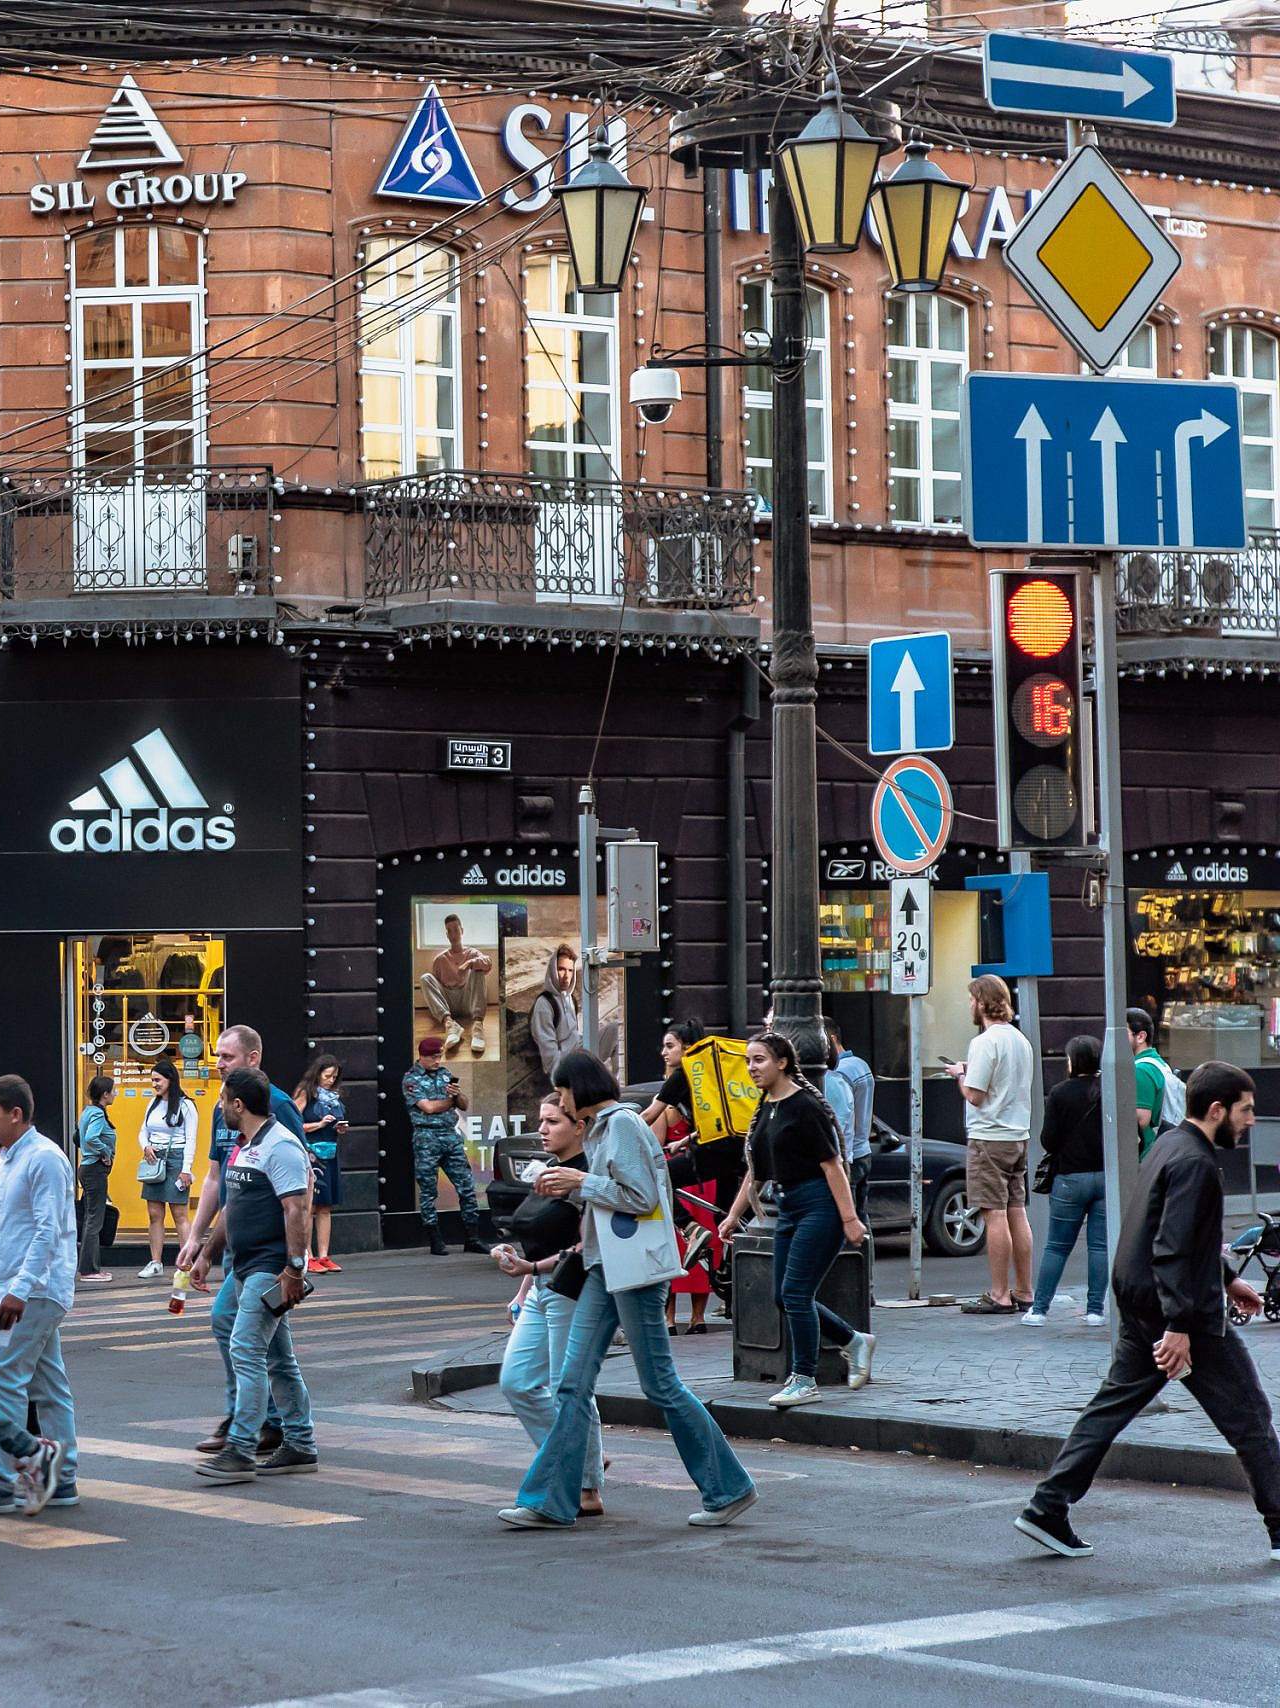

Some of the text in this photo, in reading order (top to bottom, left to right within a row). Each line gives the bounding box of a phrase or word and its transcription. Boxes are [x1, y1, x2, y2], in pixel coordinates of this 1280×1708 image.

[30, 172, 248, 212] SIL GROUP
[1033, 683, 1068, 736] 16
[453, 756, 488, 764] Arami
[493, 748, 504, 764] 3
[49, 808, 236, 852] adidas
[496, 864, 566, 886] adidas
[1193, 862, 1249, 882] adidas
[897, 932, 922, 951] 20
[727, 1081, 764, 1100] Glo
